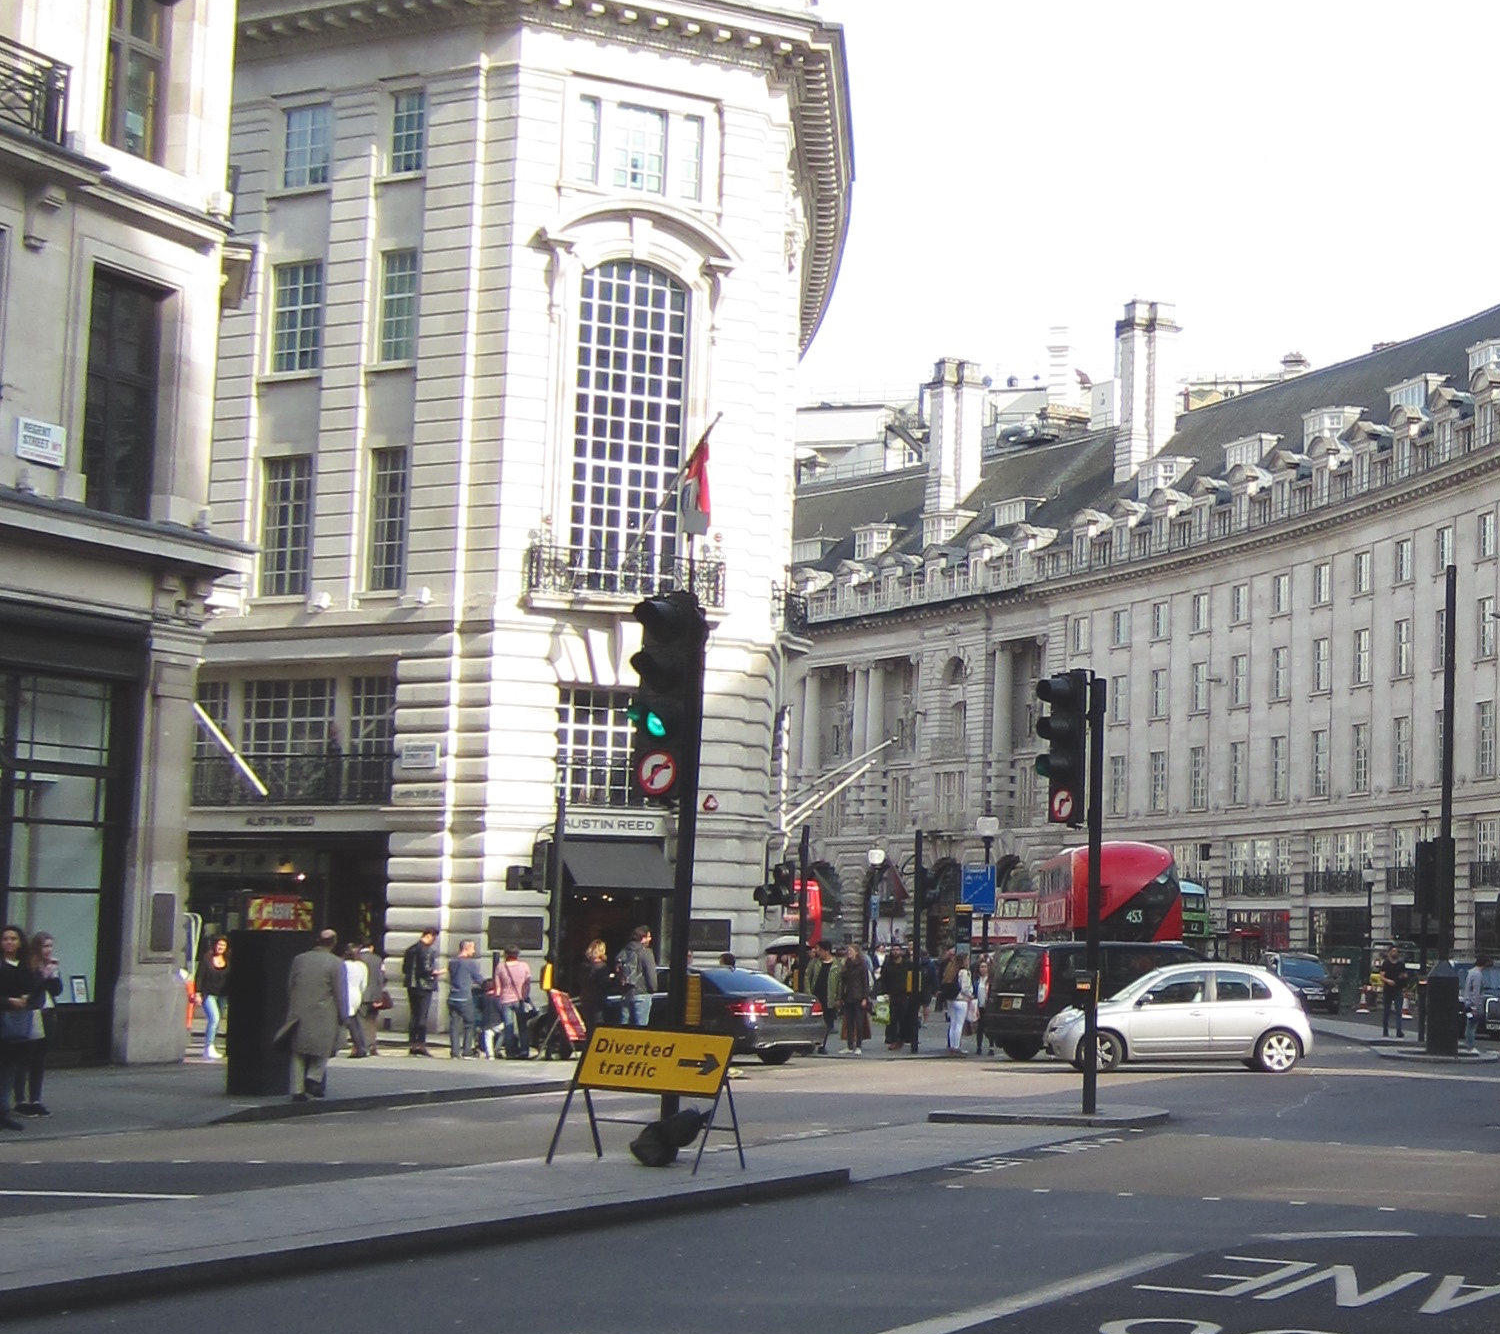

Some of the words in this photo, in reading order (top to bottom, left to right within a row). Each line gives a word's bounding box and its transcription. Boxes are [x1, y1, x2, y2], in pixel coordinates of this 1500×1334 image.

[24, 421, 52, 438] REGENT
[23, 434, 50, 450] STREET
[245, 816, 284, 827] AUSTIN
[286, 816, 316, 827] REED
[564, 818, 614, 830] AUSTIN
[616, 819, 656, 831] REED
[1125, 910, 1143, 924] 453
[1190, 922, 1199, 932] 12
[595, 1037, 675, 1058] Diverted
[599, 1060, 657, 1078] traffic
